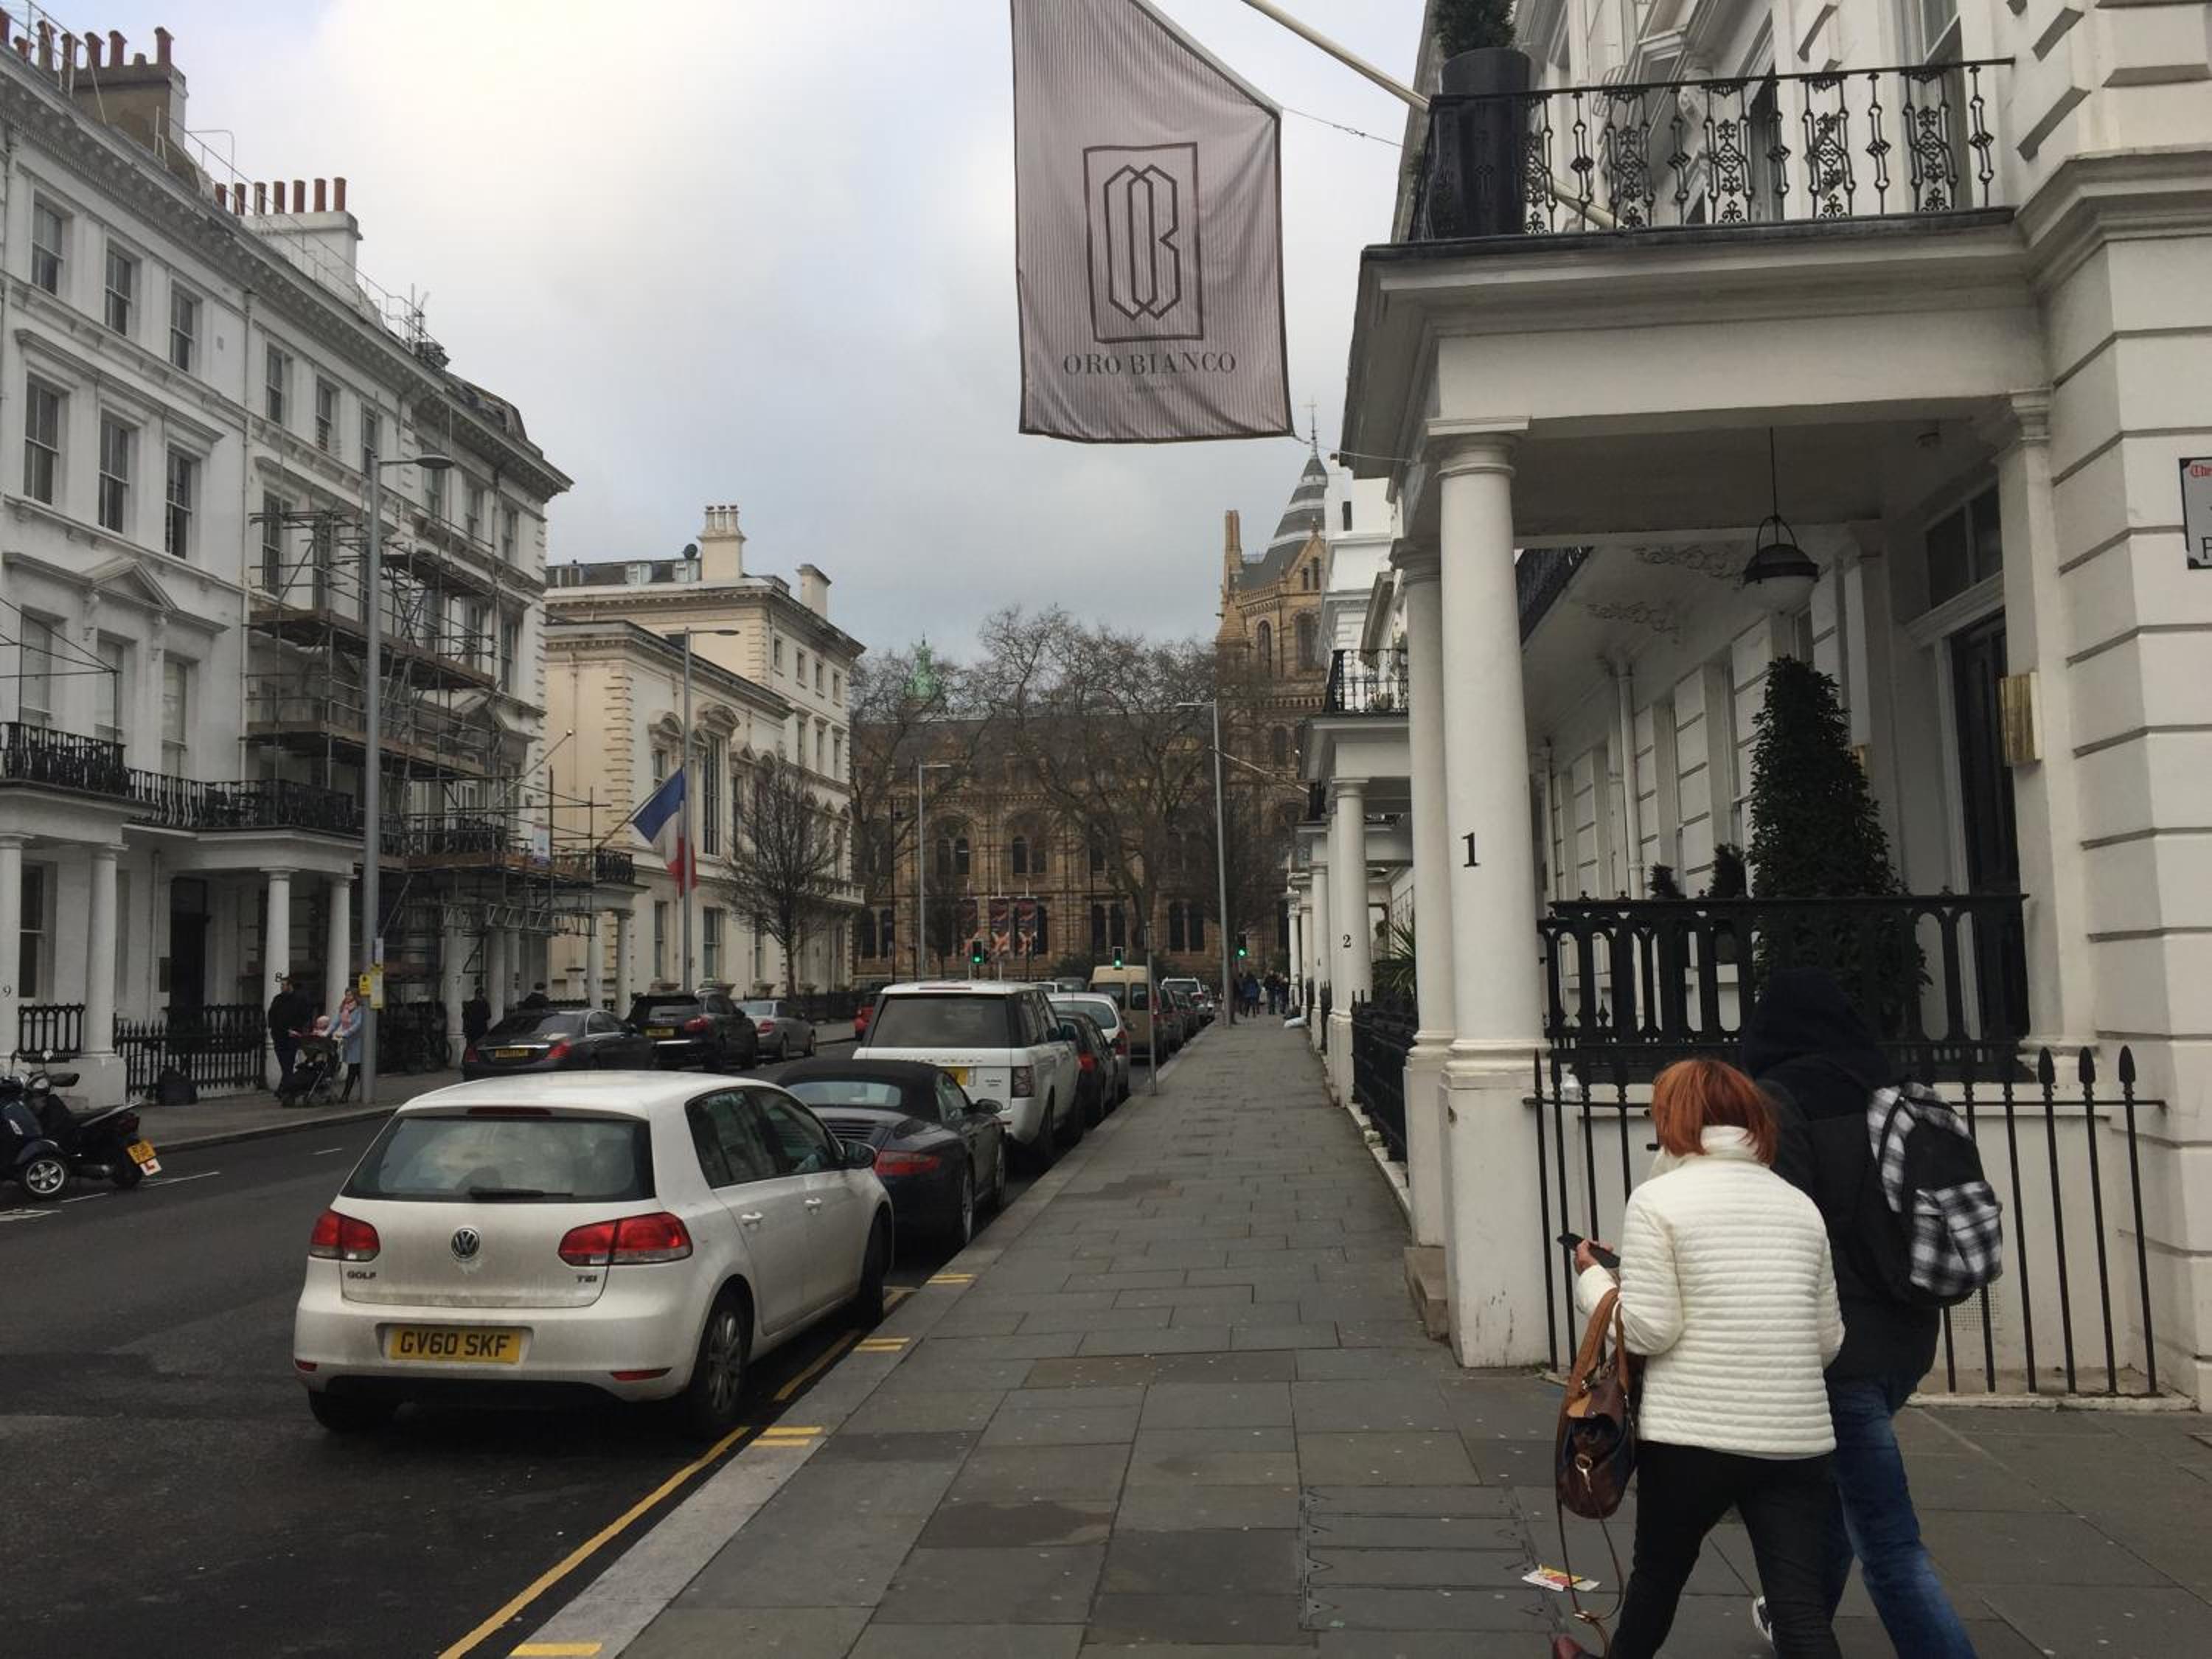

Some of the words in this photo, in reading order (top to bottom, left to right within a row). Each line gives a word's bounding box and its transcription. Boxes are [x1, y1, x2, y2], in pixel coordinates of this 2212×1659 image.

[1063, 353, 1121, 375] ORO
[1130, 352, 1237, 375] BIANCO
[1462, 832, 1480, 868] 1
[1343, 934, 1352, 948] 2
[275, 972, 282, 983] 8
[3, 985, 11, 997] 9
[400, 1331, 458, 1355] GV60
[464, 1334, 510, 1357] SKF
